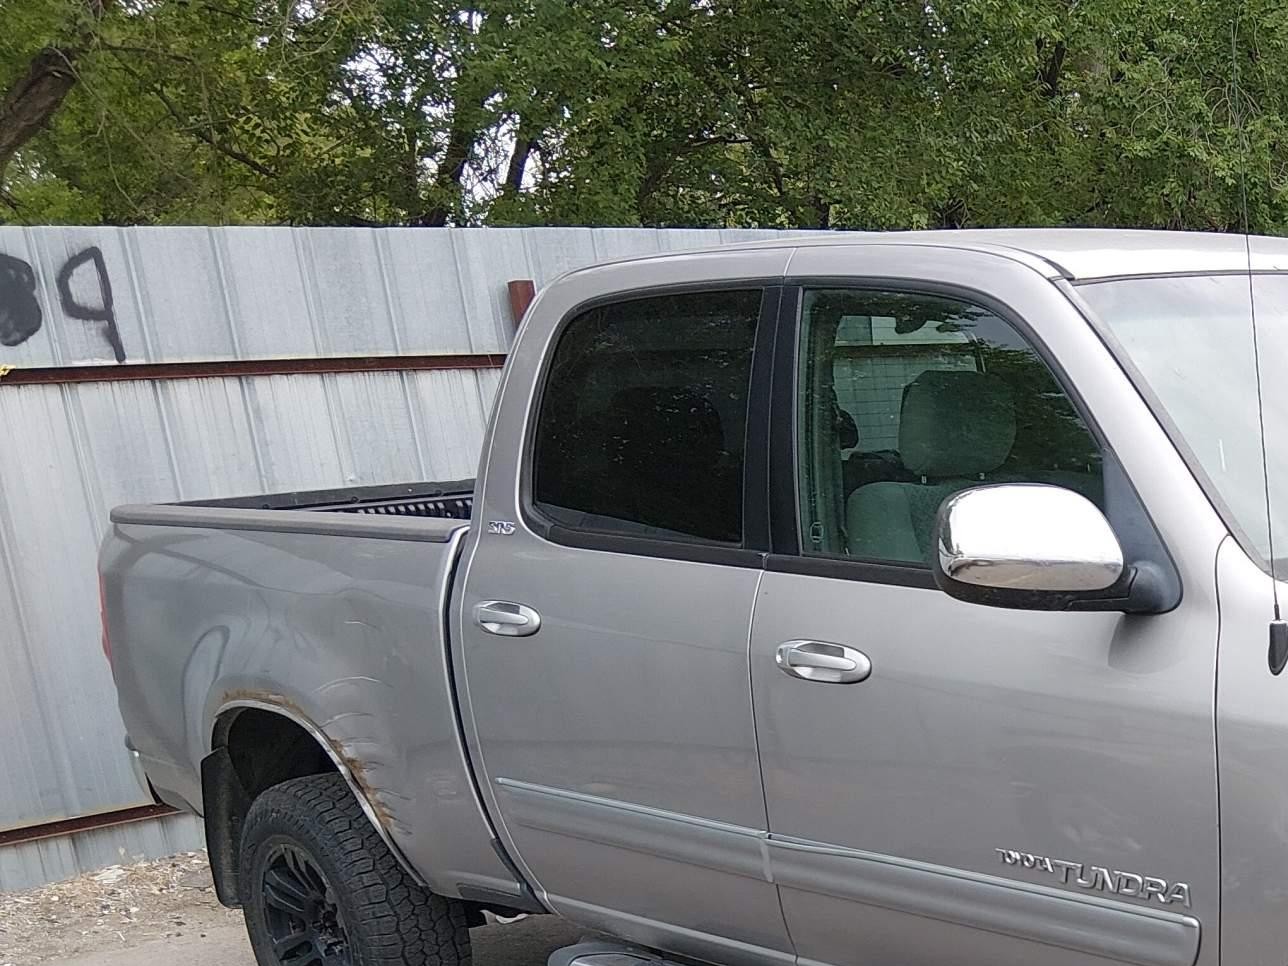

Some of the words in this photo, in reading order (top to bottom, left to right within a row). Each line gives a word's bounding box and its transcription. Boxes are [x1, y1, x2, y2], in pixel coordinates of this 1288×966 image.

[57, 246, 126, 363] 9
[995, 848, 1054, 873] TOYOTA
[1053, 858, 1192, 908] TUNDRA
